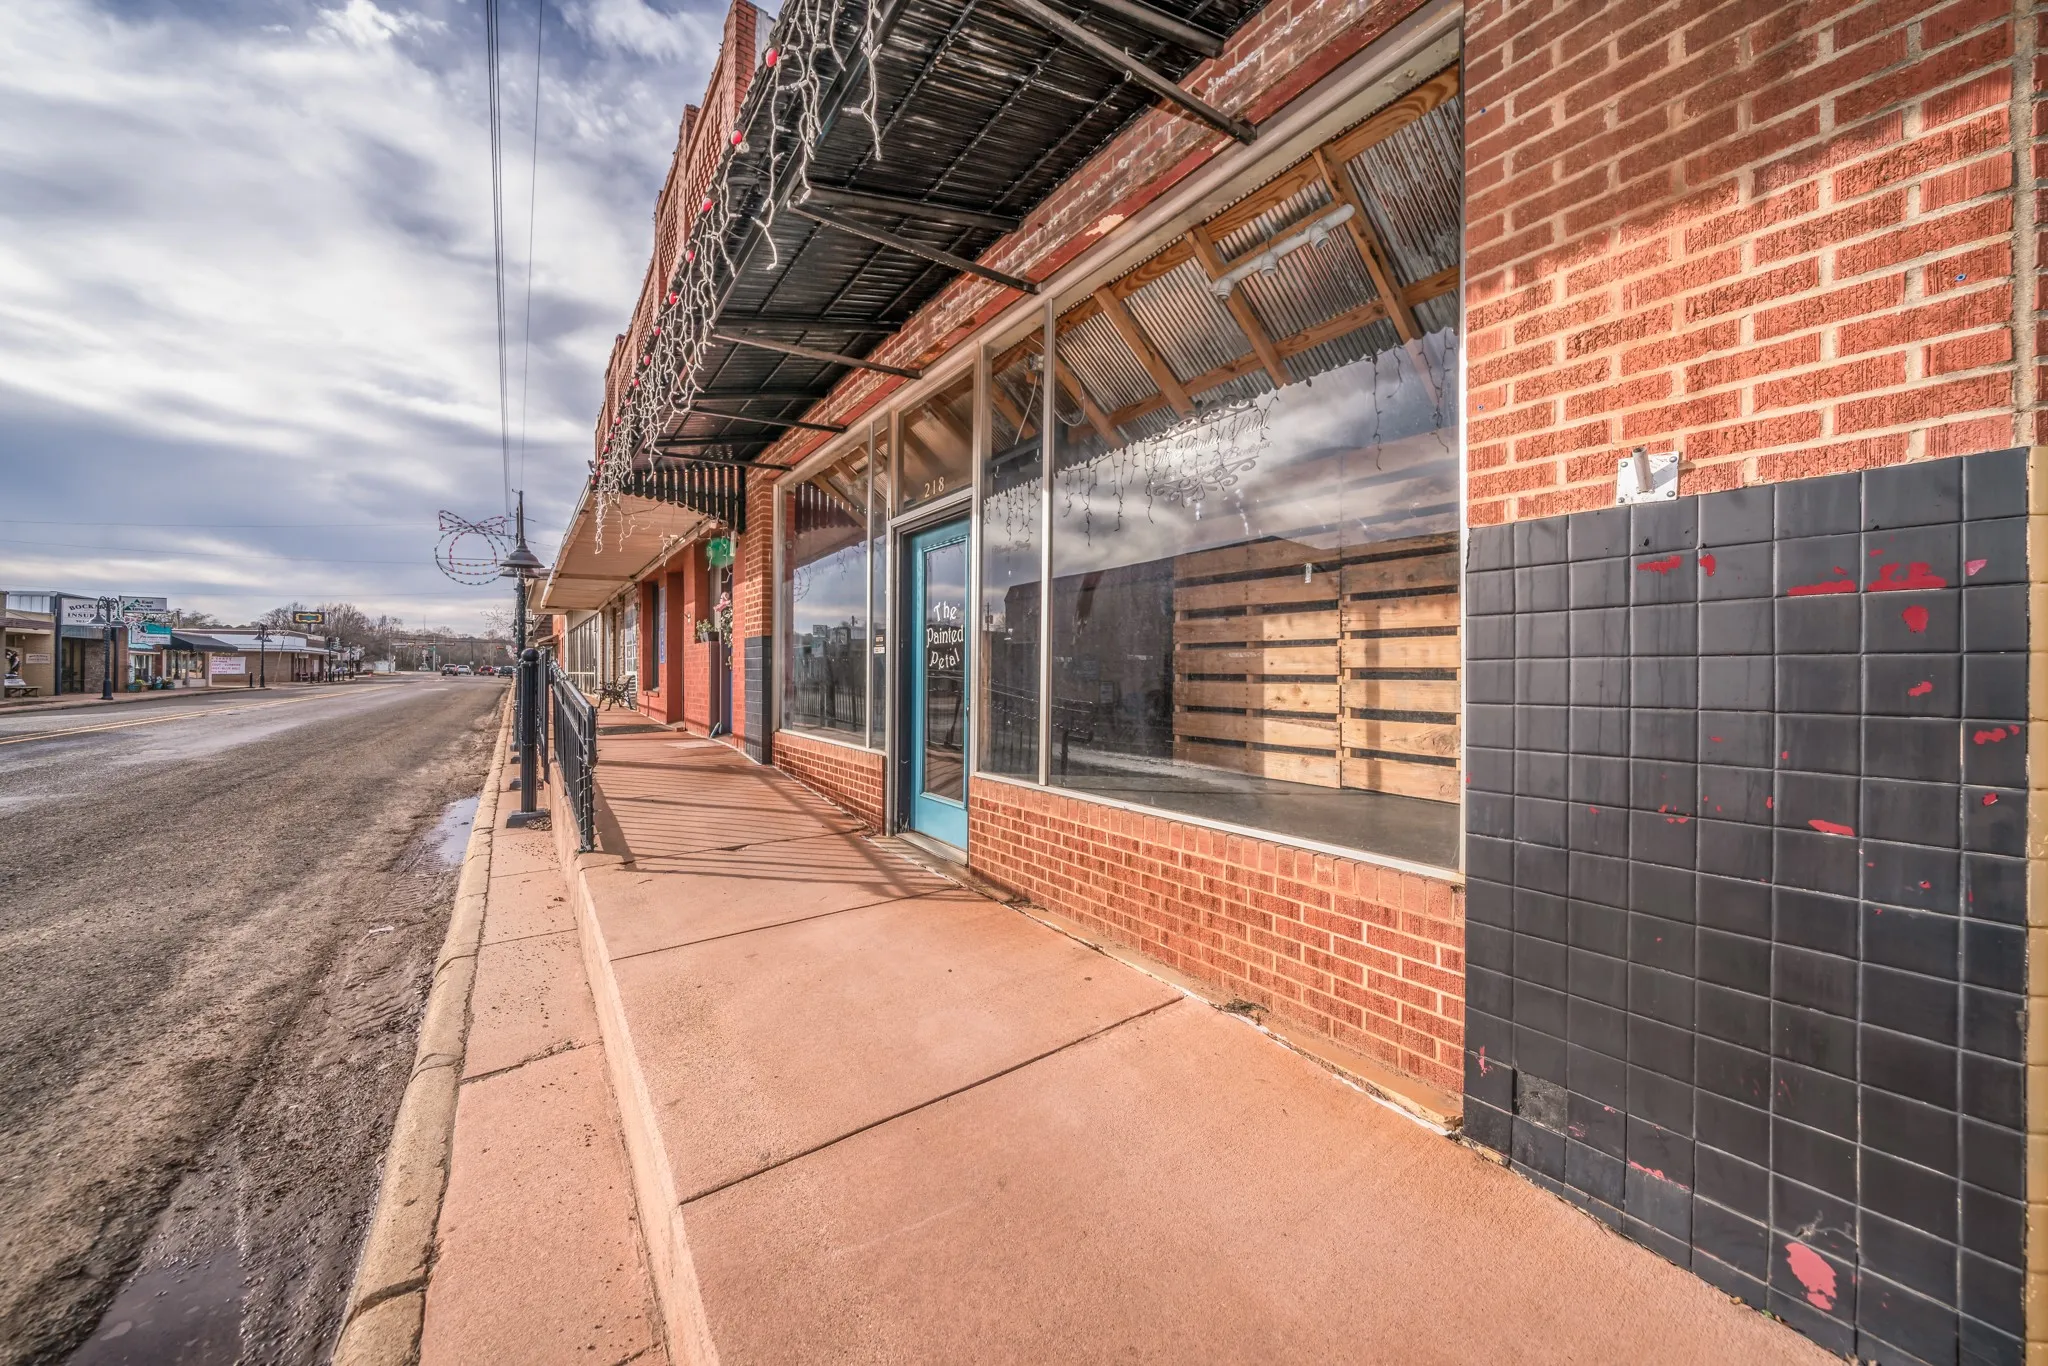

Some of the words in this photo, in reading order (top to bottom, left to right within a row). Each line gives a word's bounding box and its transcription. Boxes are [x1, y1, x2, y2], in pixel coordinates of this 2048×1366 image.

[1176, 426, 1226, 451] Painted
[1228, 409, 1272, 440] Petal
[924, 476, 944, 499] 218
[933, 600, 958, 622] The
[926, 624, 964, 649] Painted
[929, 647, 960, 670] Petal
